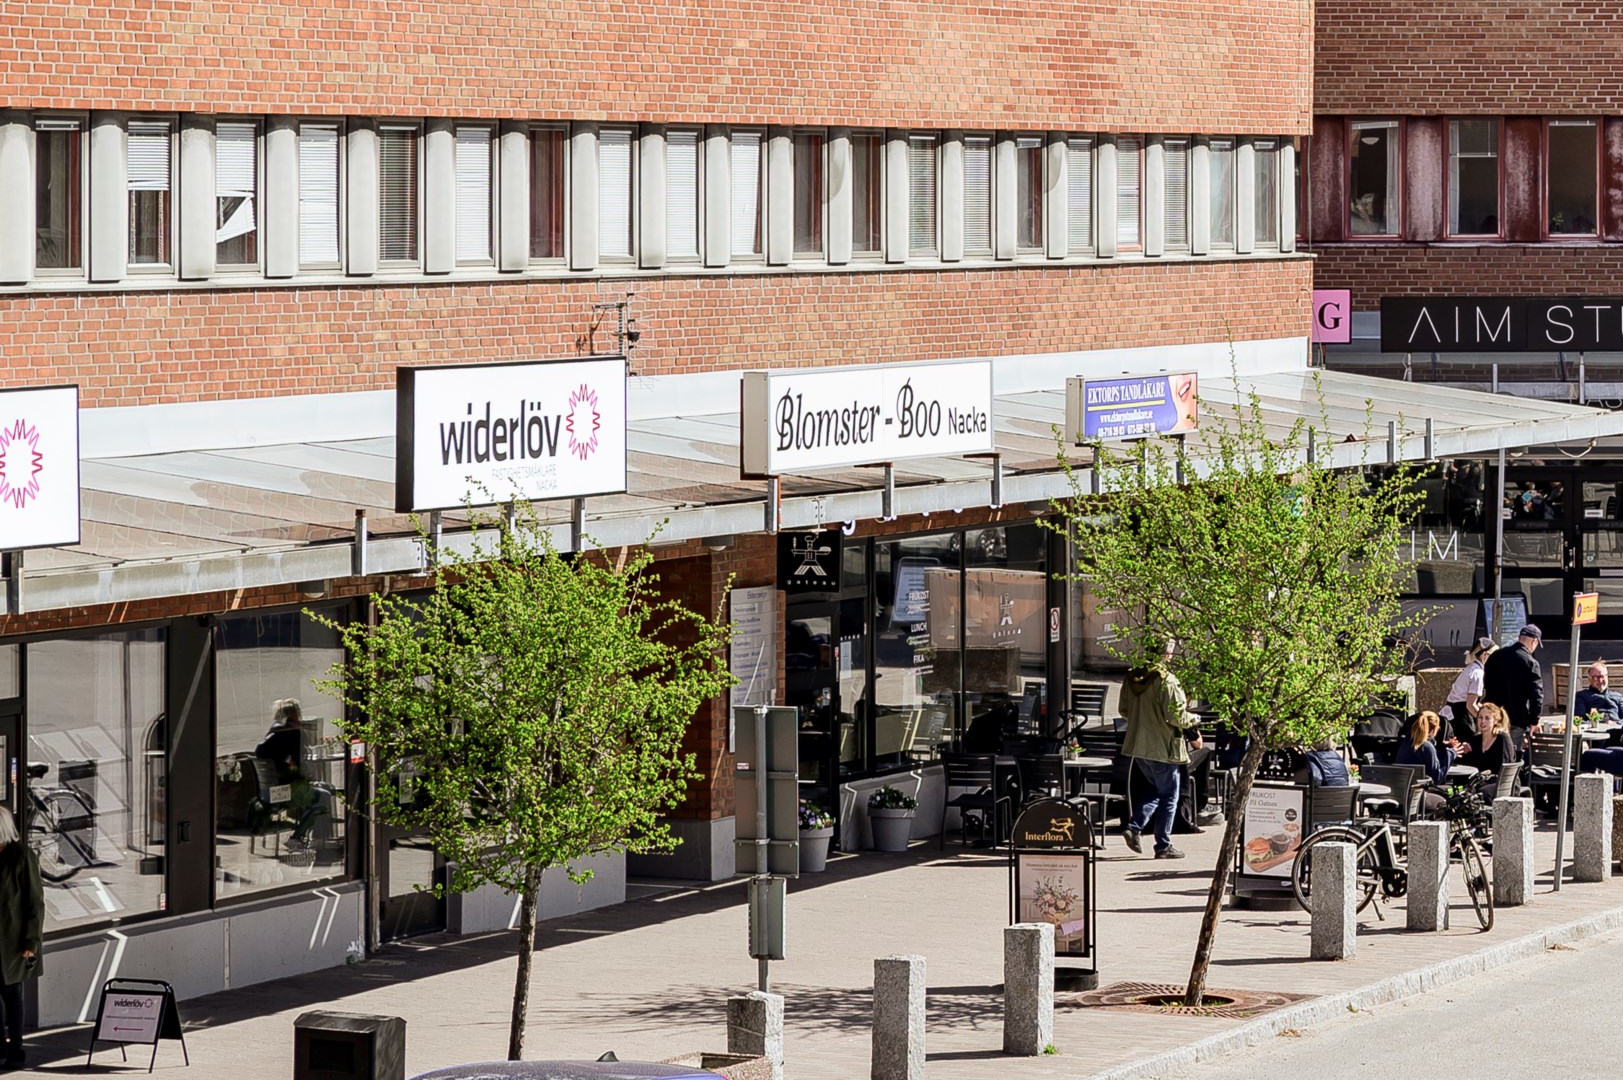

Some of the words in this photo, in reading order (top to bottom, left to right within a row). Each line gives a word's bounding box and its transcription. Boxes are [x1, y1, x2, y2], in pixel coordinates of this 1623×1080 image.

[1408, 305, 1511, 344] AIM
[1088, 385, 1120, 404] EKTORPS
[776, 388, 880, 451] Blomster
[896, 377, 942, 438] Boo
[948, 406, 987, 435] Nacka
[440, 399, 561, 466] widerlöv
[786, 579, 837, 587] gateau
[910, 622, 928, 633] LUNCH
[913, 654, 925, 664] FIKA
[1025, 831, 1065, 841] Interflora
[114, 998, 145, 1008] widerlöv
